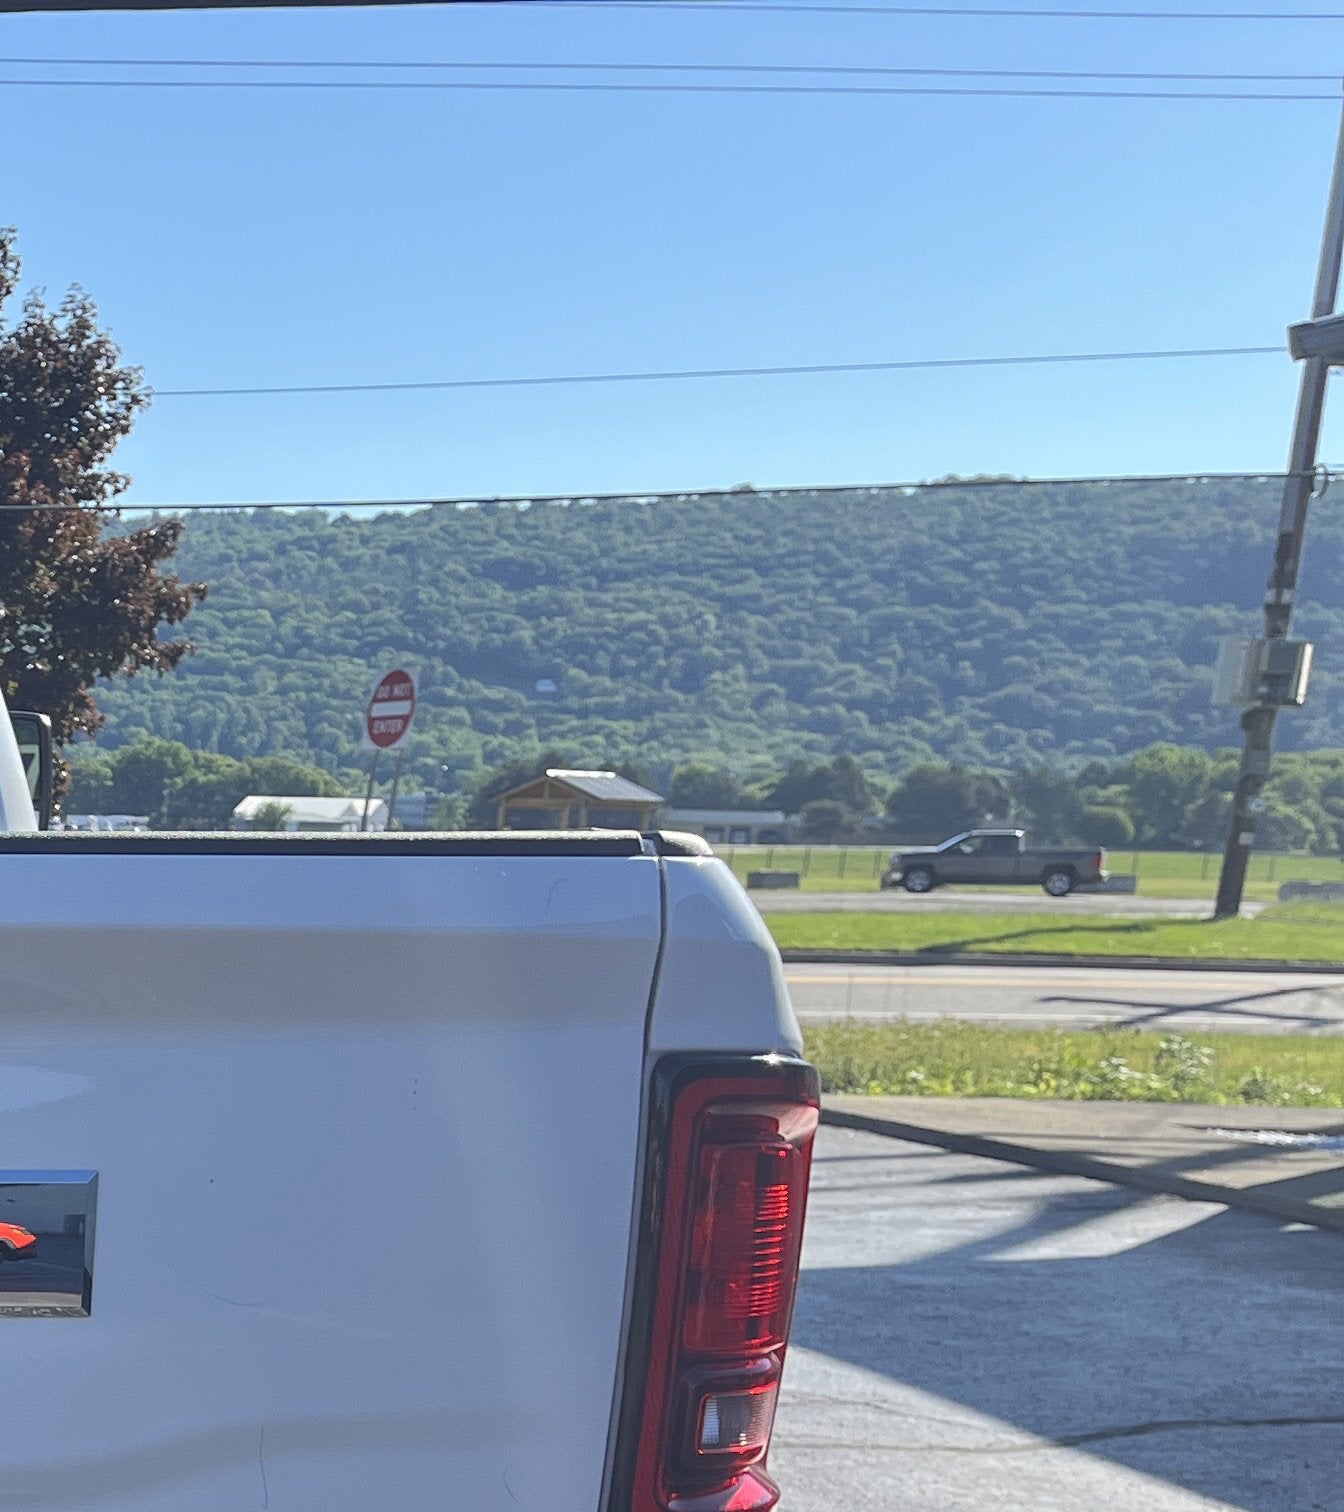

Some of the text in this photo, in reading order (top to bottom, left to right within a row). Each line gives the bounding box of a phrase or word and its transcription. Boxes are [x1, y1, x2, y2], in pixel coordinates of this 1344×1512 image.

[376, 682, 412, 698] DO NOT
[374, 719, 404, 735] ENTER
